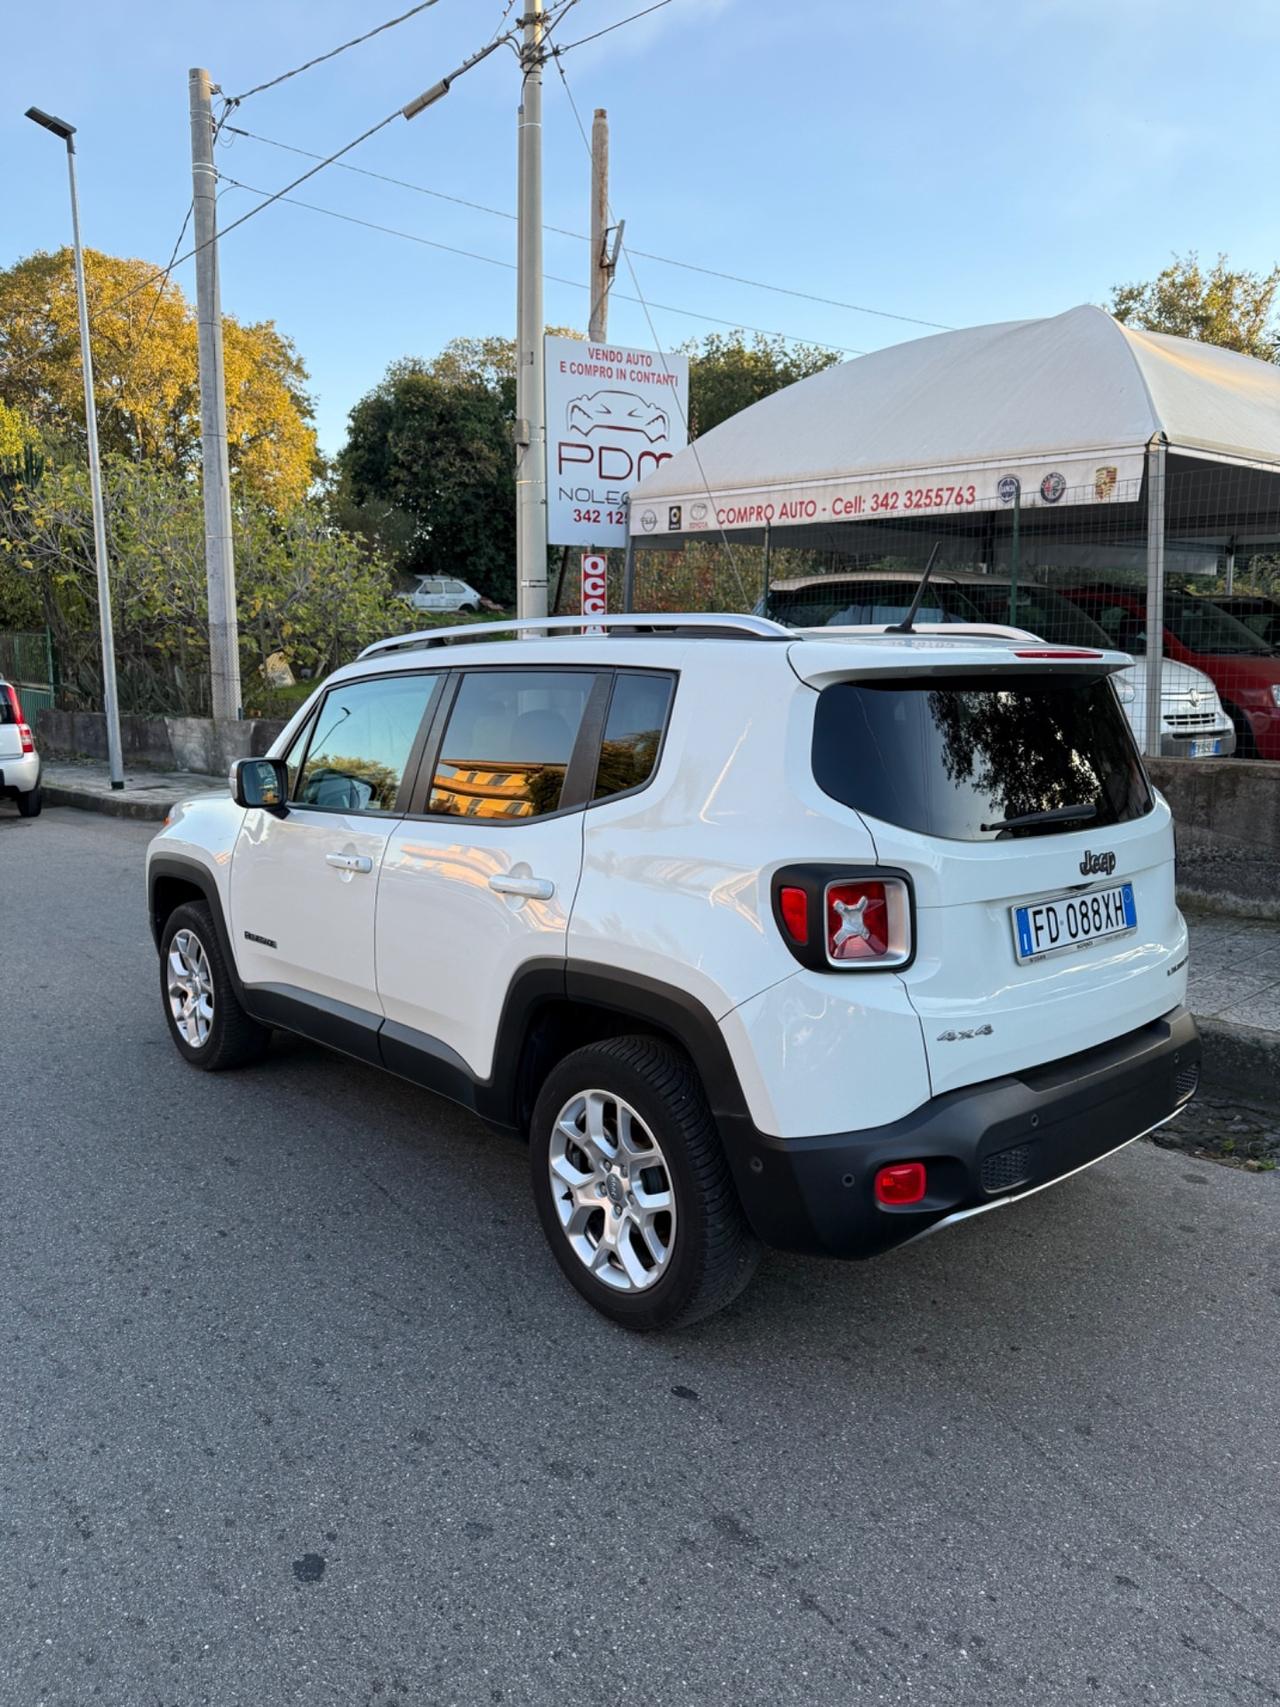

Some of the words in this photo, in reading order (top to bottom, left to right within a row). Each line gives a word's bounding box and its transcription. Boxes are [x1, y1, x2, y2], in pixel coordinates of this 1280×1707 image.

[588, 347, 623, 363] VENDO
[626, 352, 653, 367] AUTO
[560, 361, 566, 373] E
[569, 363, 613, 379] COMPRO
[616, 367, 626, 381] IN
[629, 369, 678, 387] CONTANTI
[573, 508, 601, 523] 342
[716, 503, 775, 525] COMPRO
[779, 499, 817, 519] AUTO
[831, 496, 866, 516] Cell:
[870, 491, 900, 512] 342
[904, 485, 976, 509] 3255763
[1079, 850, 1116, 876] Jeep
[1032, 906, 1060, 948] FD
[1066, 890, 1125, 939] 088XH
